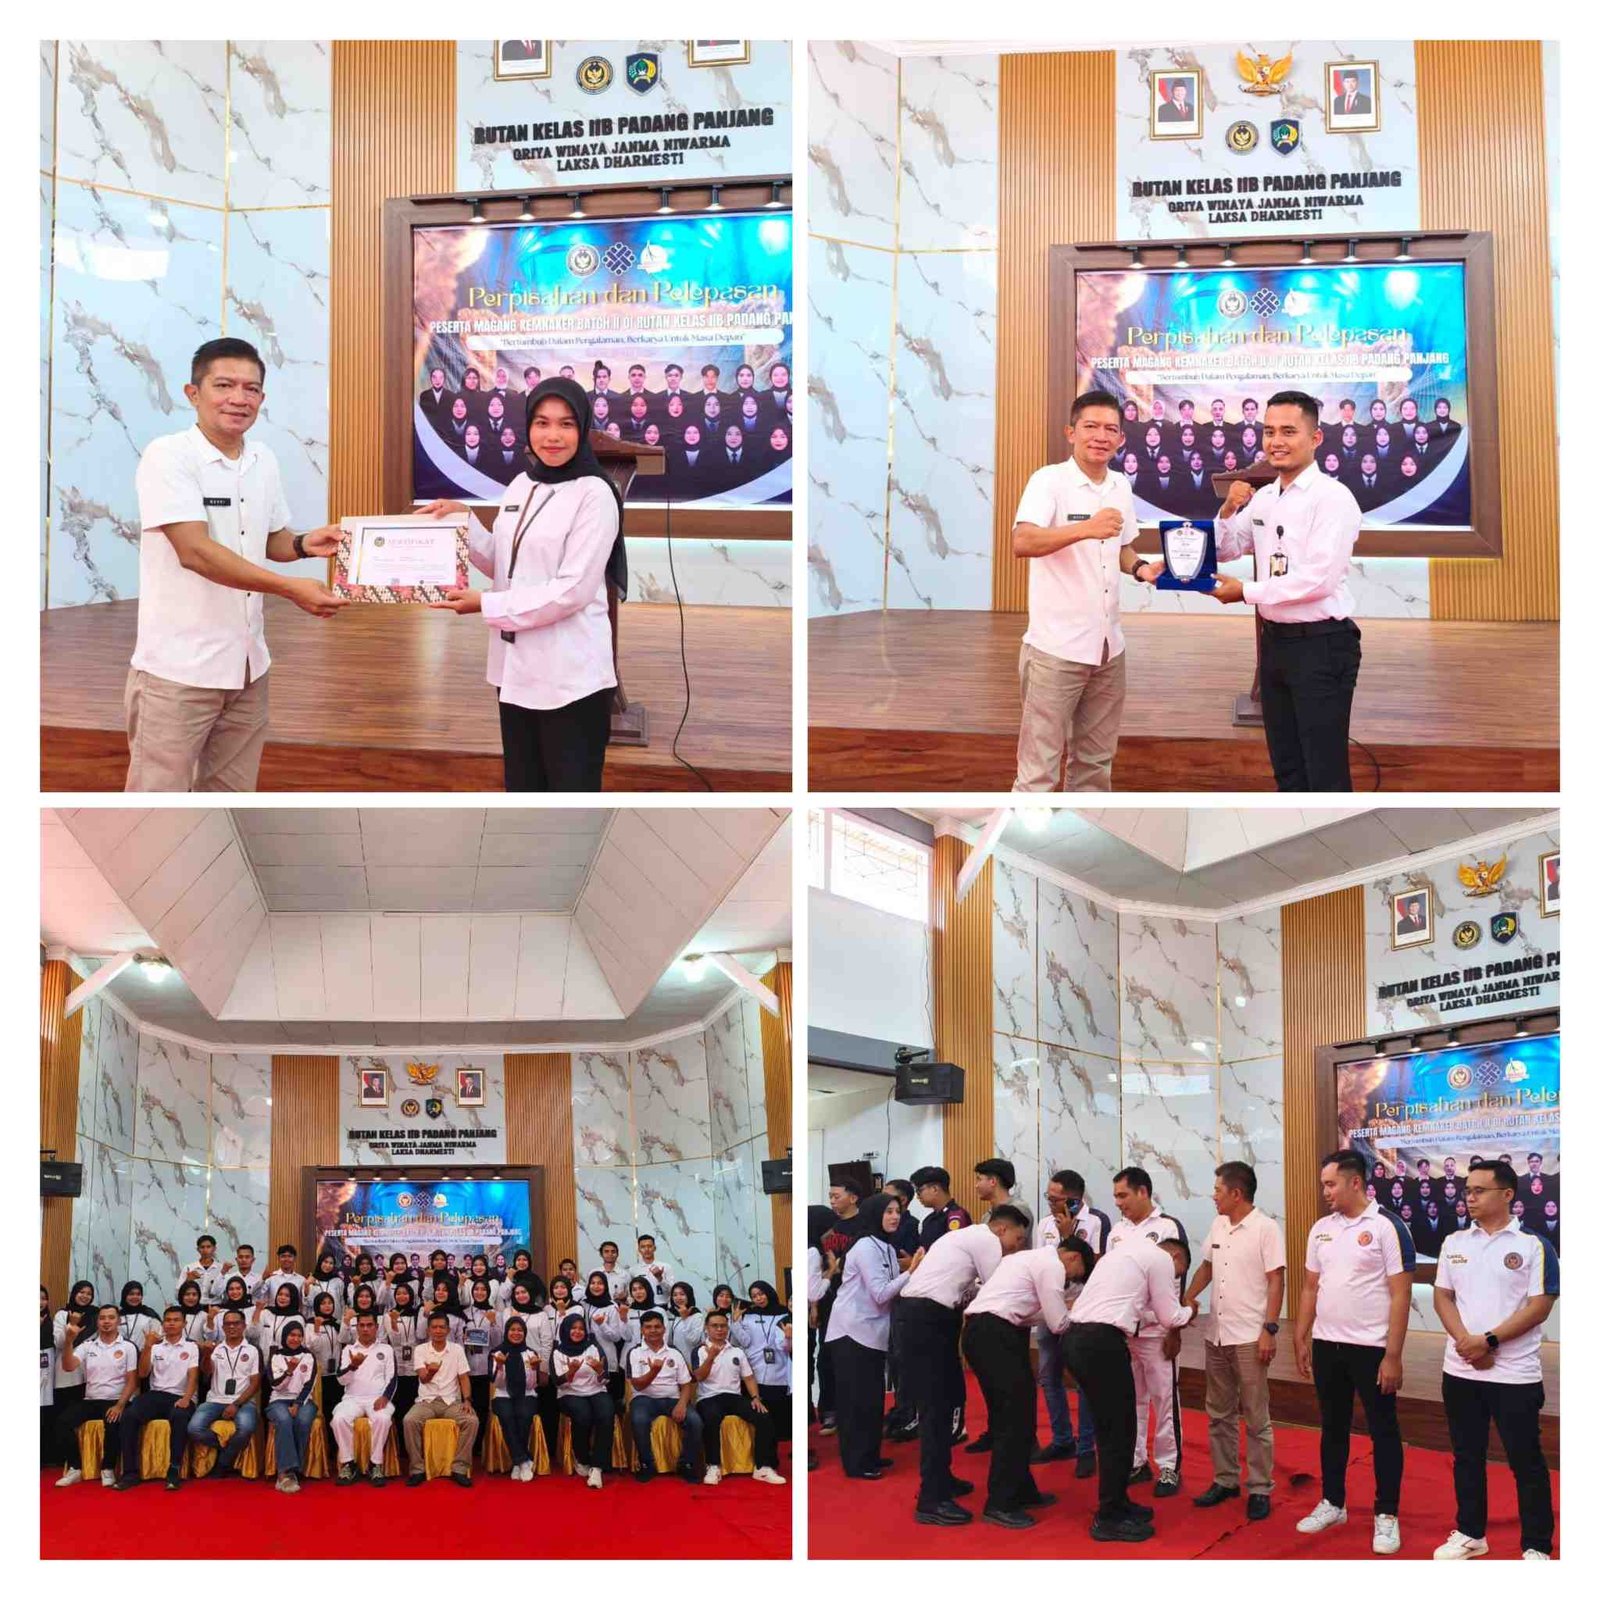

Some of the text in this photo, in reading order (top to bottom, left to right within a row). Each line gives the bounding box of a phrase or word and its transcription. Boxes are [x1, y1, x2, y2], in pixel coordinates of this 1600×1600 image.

[474, 107, 774, 145] RUTAN KELAS IIB PADANG PANJANG
[513, 135, 731, 161] GRIYA WINAYA JANMA NIWARMA
[557, 152, 684, 172] LAKSA DHARMESTI
[1132, 171, 1402, 197] RUTAN KELAS IIB PADANG PANJANG
[1168, 194, 1364, 213] GRIYA WINAYA JANMA NIWARMA
[1208, 208, 1322, 223] LAKSA DHARMESTI
[469, 280, 778, 314] Perpisahan dan Pelepasan
[429, 320, 472, 334] PESERTA
[474, 318, 516, 333] MAGANG
[520, 316, 574, 332] KEMNAKER
[578, 316, 610, 331] BATCH
[637, 314, 673, 329] RUTAN
[673, 313, 705, 328] KELAS
[709, 312, 724, 327] IIB
[726, 311, 771, 327] PADANG
[1250, 324, 1291, 345] dan
[1296, 323, 1408, 349] Pelepasan
[1091, 356, 1130, 369] PESERTA
[1361, 352, 1401, 365] PADANG
[1404, 352, 1450, 364] PANJANG
[1421, 971, 1461, 991] KELAS
[1486, 954, 1543, 978] PADANG
[1438, 986, 1479, 1002] WINAYA
[1481, 978, 1520, 993] JANMA
[1439, 985, 1541, 1012] LAKSA DHARMESTI
[1478, 1091, 1513, 1109] dan
[379, 1129, 406, 1139] KELAS
